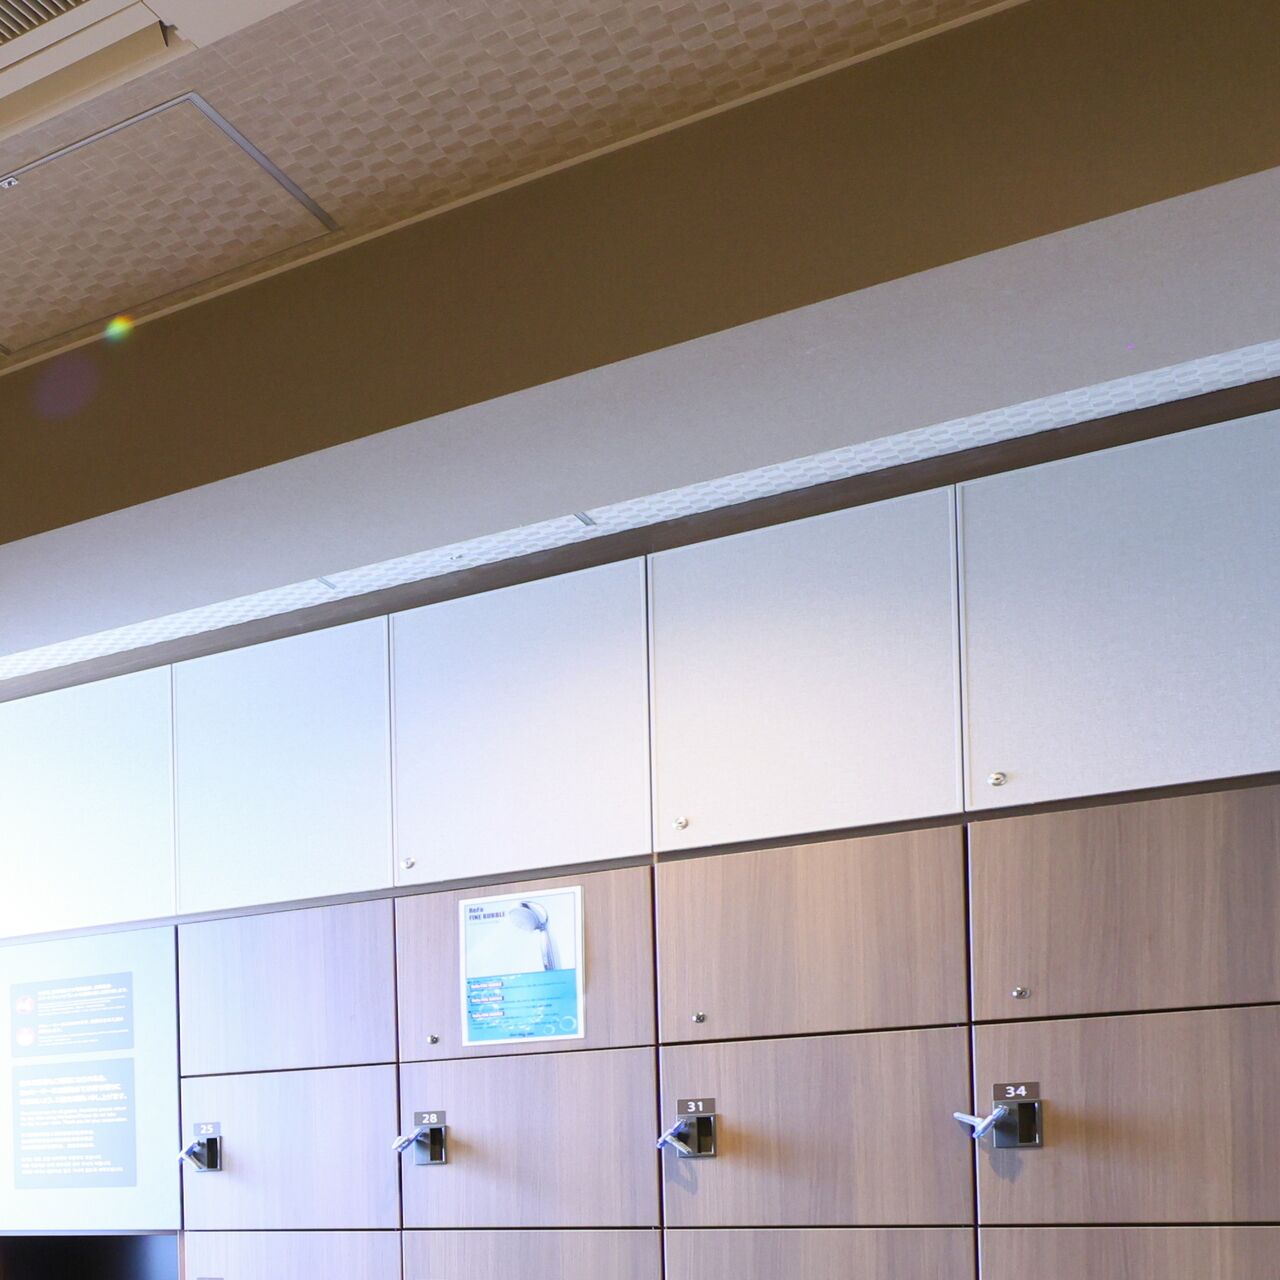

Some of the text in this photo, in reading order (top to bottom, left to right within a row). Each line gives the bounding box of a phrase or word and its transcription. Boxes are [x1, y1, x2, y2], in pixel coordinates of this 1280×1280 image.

[1005, 1085, 1028, 1098] 34
[687, 1101, 703, 1113] 31
[422, 1113, 438, 1124] 28
[200, 1124, 214, 1135] 25
